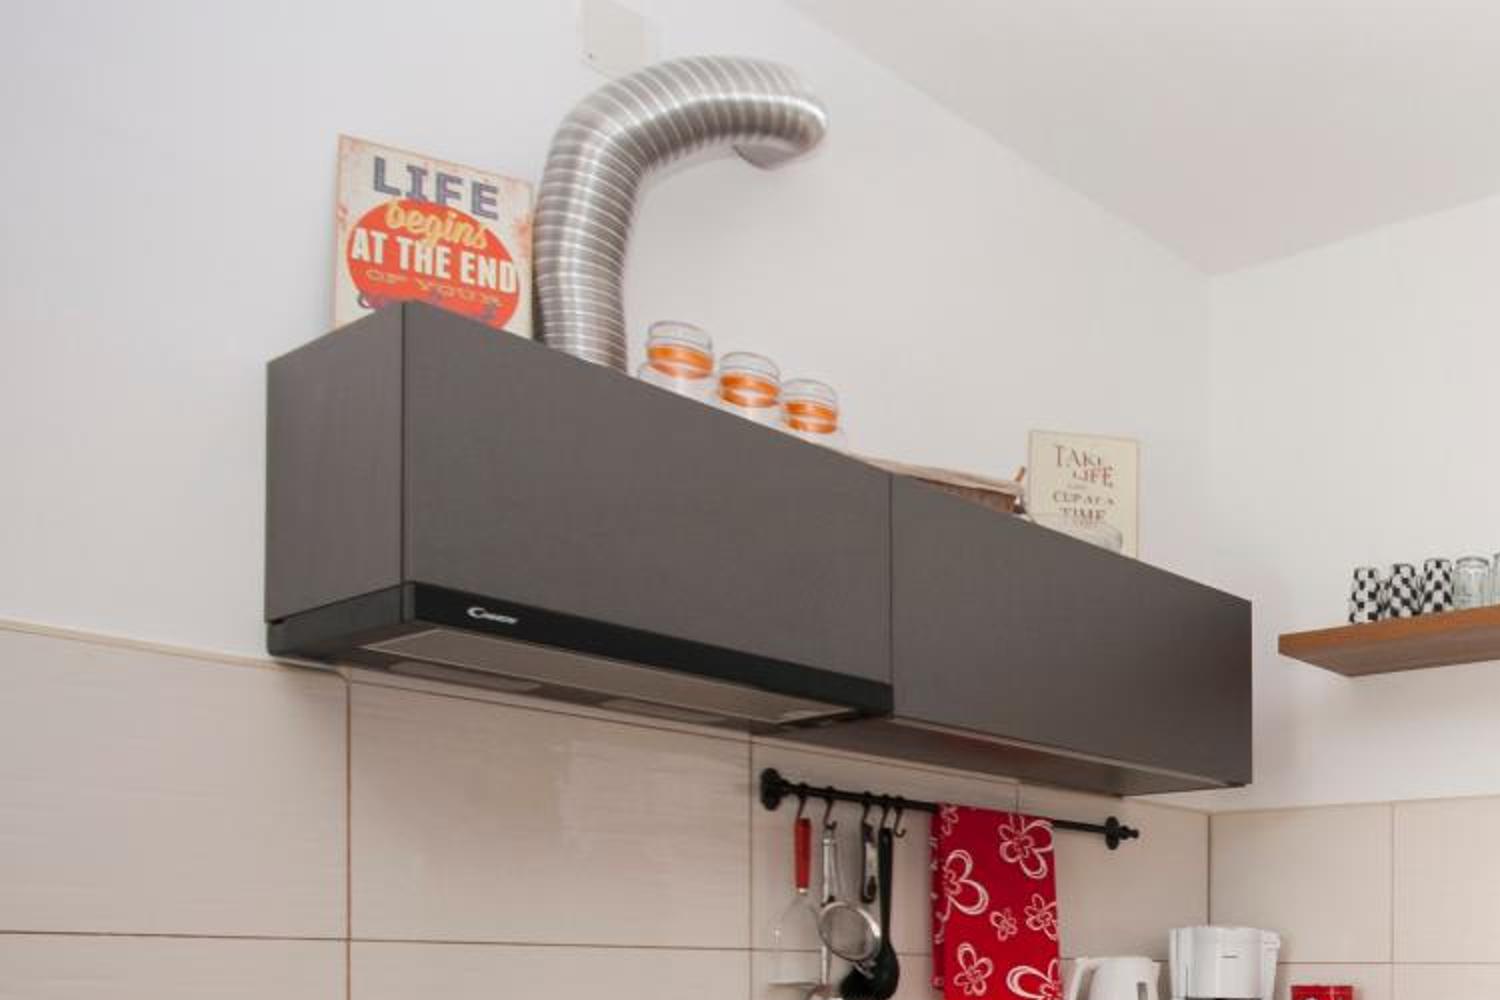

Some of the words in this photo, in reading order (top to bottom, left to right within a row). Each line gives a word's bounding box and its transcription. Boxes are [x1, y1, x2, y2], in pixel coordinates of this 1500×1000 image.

[373, 156, 499, 221] LIFE
[384, 201, 489, 251] begins
[351, 227, 389, 265] AT
[397, 234, 452, 281] THE
[460, 246, 518, 295] END
